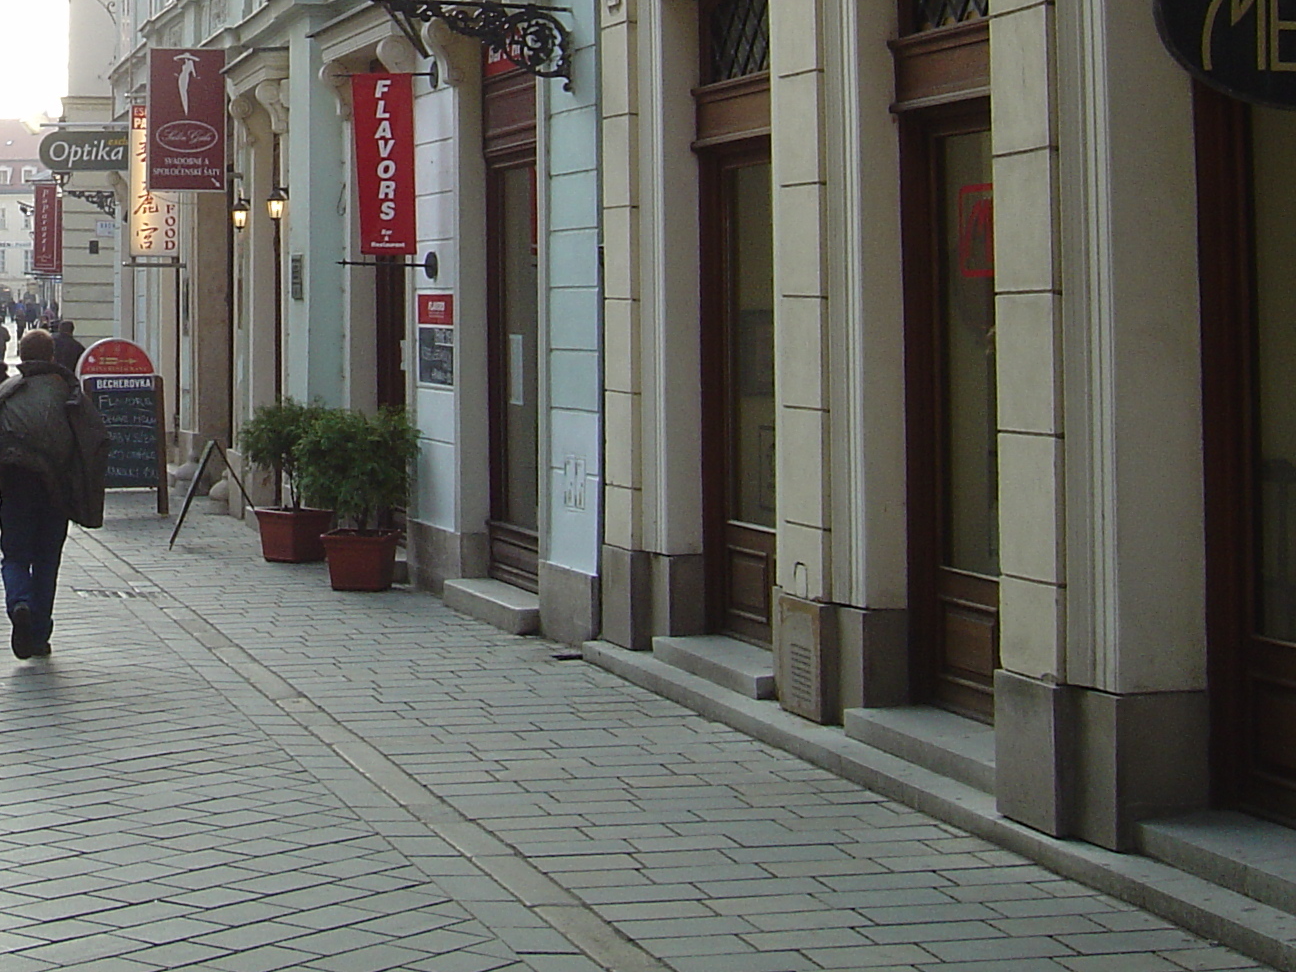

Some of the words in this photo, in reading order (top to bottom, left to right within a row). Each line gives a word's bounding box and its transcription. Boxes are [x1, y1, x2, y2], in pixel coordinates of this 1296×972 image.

[49, 139, 124, 168] Optika
[374, 80, 396, 220] FLAVORS
[164, 204, 176, 250] FOOD
[96, 378, 151, 390] BECHEROVKA
